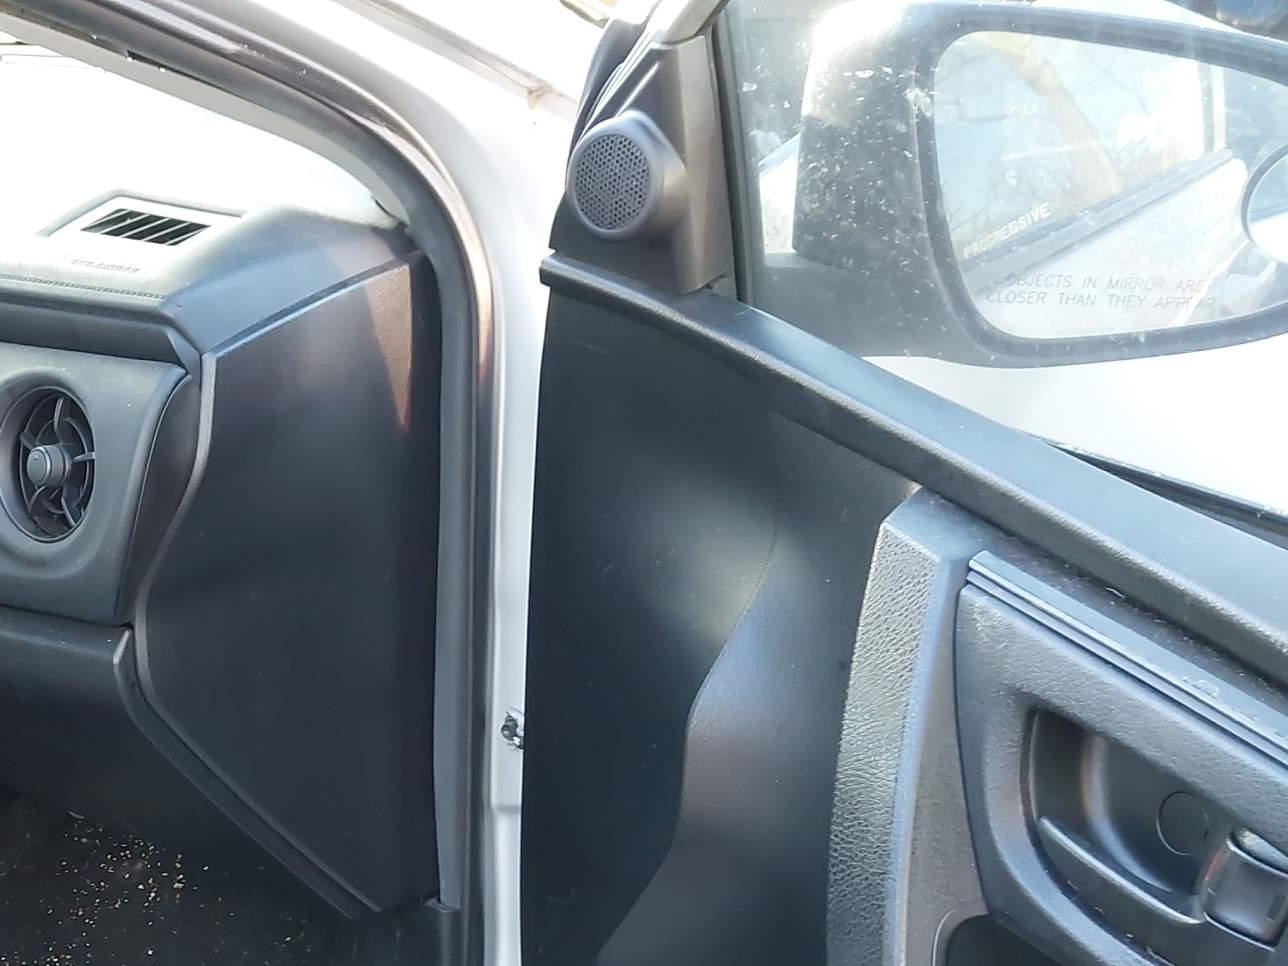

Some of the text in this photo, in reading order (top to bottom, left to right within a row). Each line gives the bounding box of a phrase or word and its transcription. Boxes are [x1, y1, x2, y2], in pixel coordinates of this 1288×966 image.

[1081, 276, 1098, 289] IN
[1108, 277, 1166, 291] MIRROR
[986, 288, 1048, 304] CLOSER
[1058, 292, 1096, 306] THAN
[1108, 294, 1145, 308] THEY
